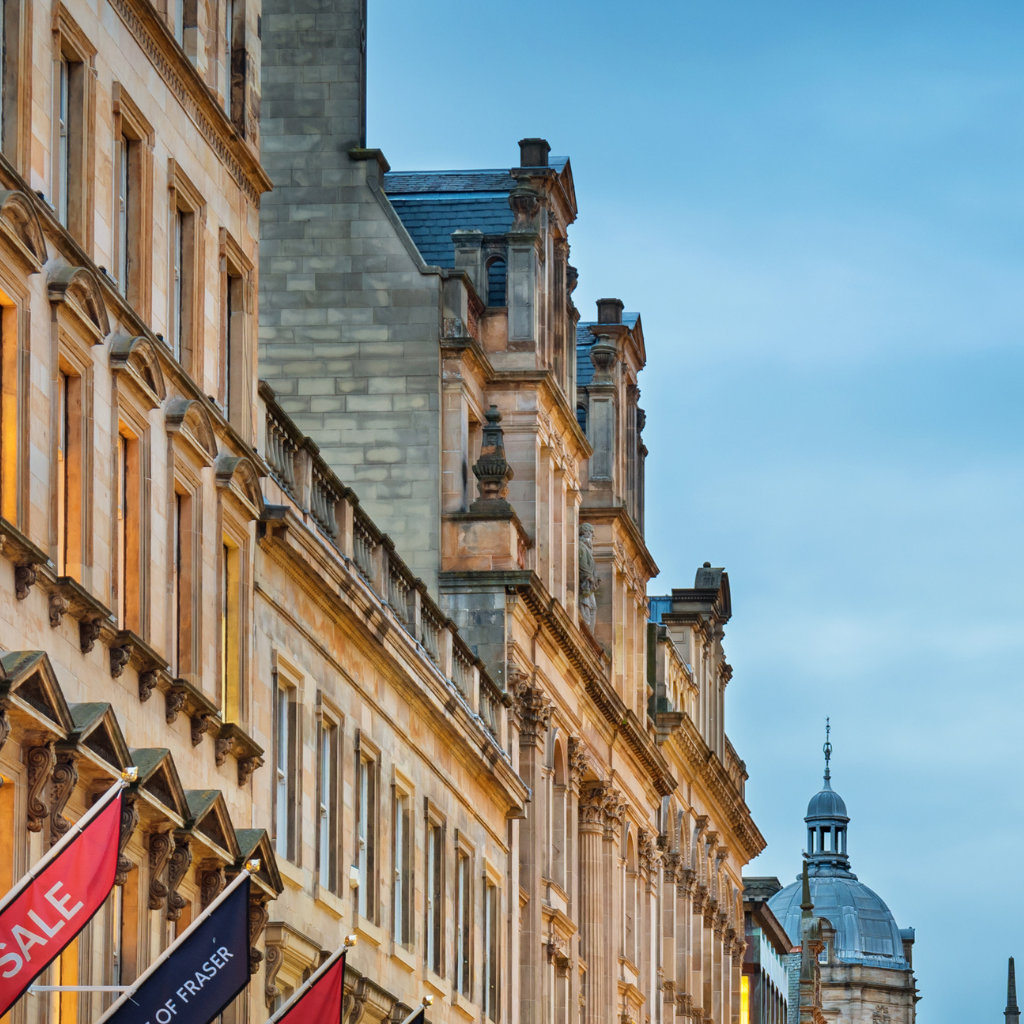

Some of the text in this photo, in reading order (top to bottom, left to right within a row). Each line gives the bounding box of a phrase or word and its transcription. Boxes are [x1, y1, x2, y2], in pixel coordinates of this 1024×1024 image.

[0, 881, 84, 978] SALE
[155, 999, 177, 1024] OF
[176, 946, 234, 1003] FRASER
